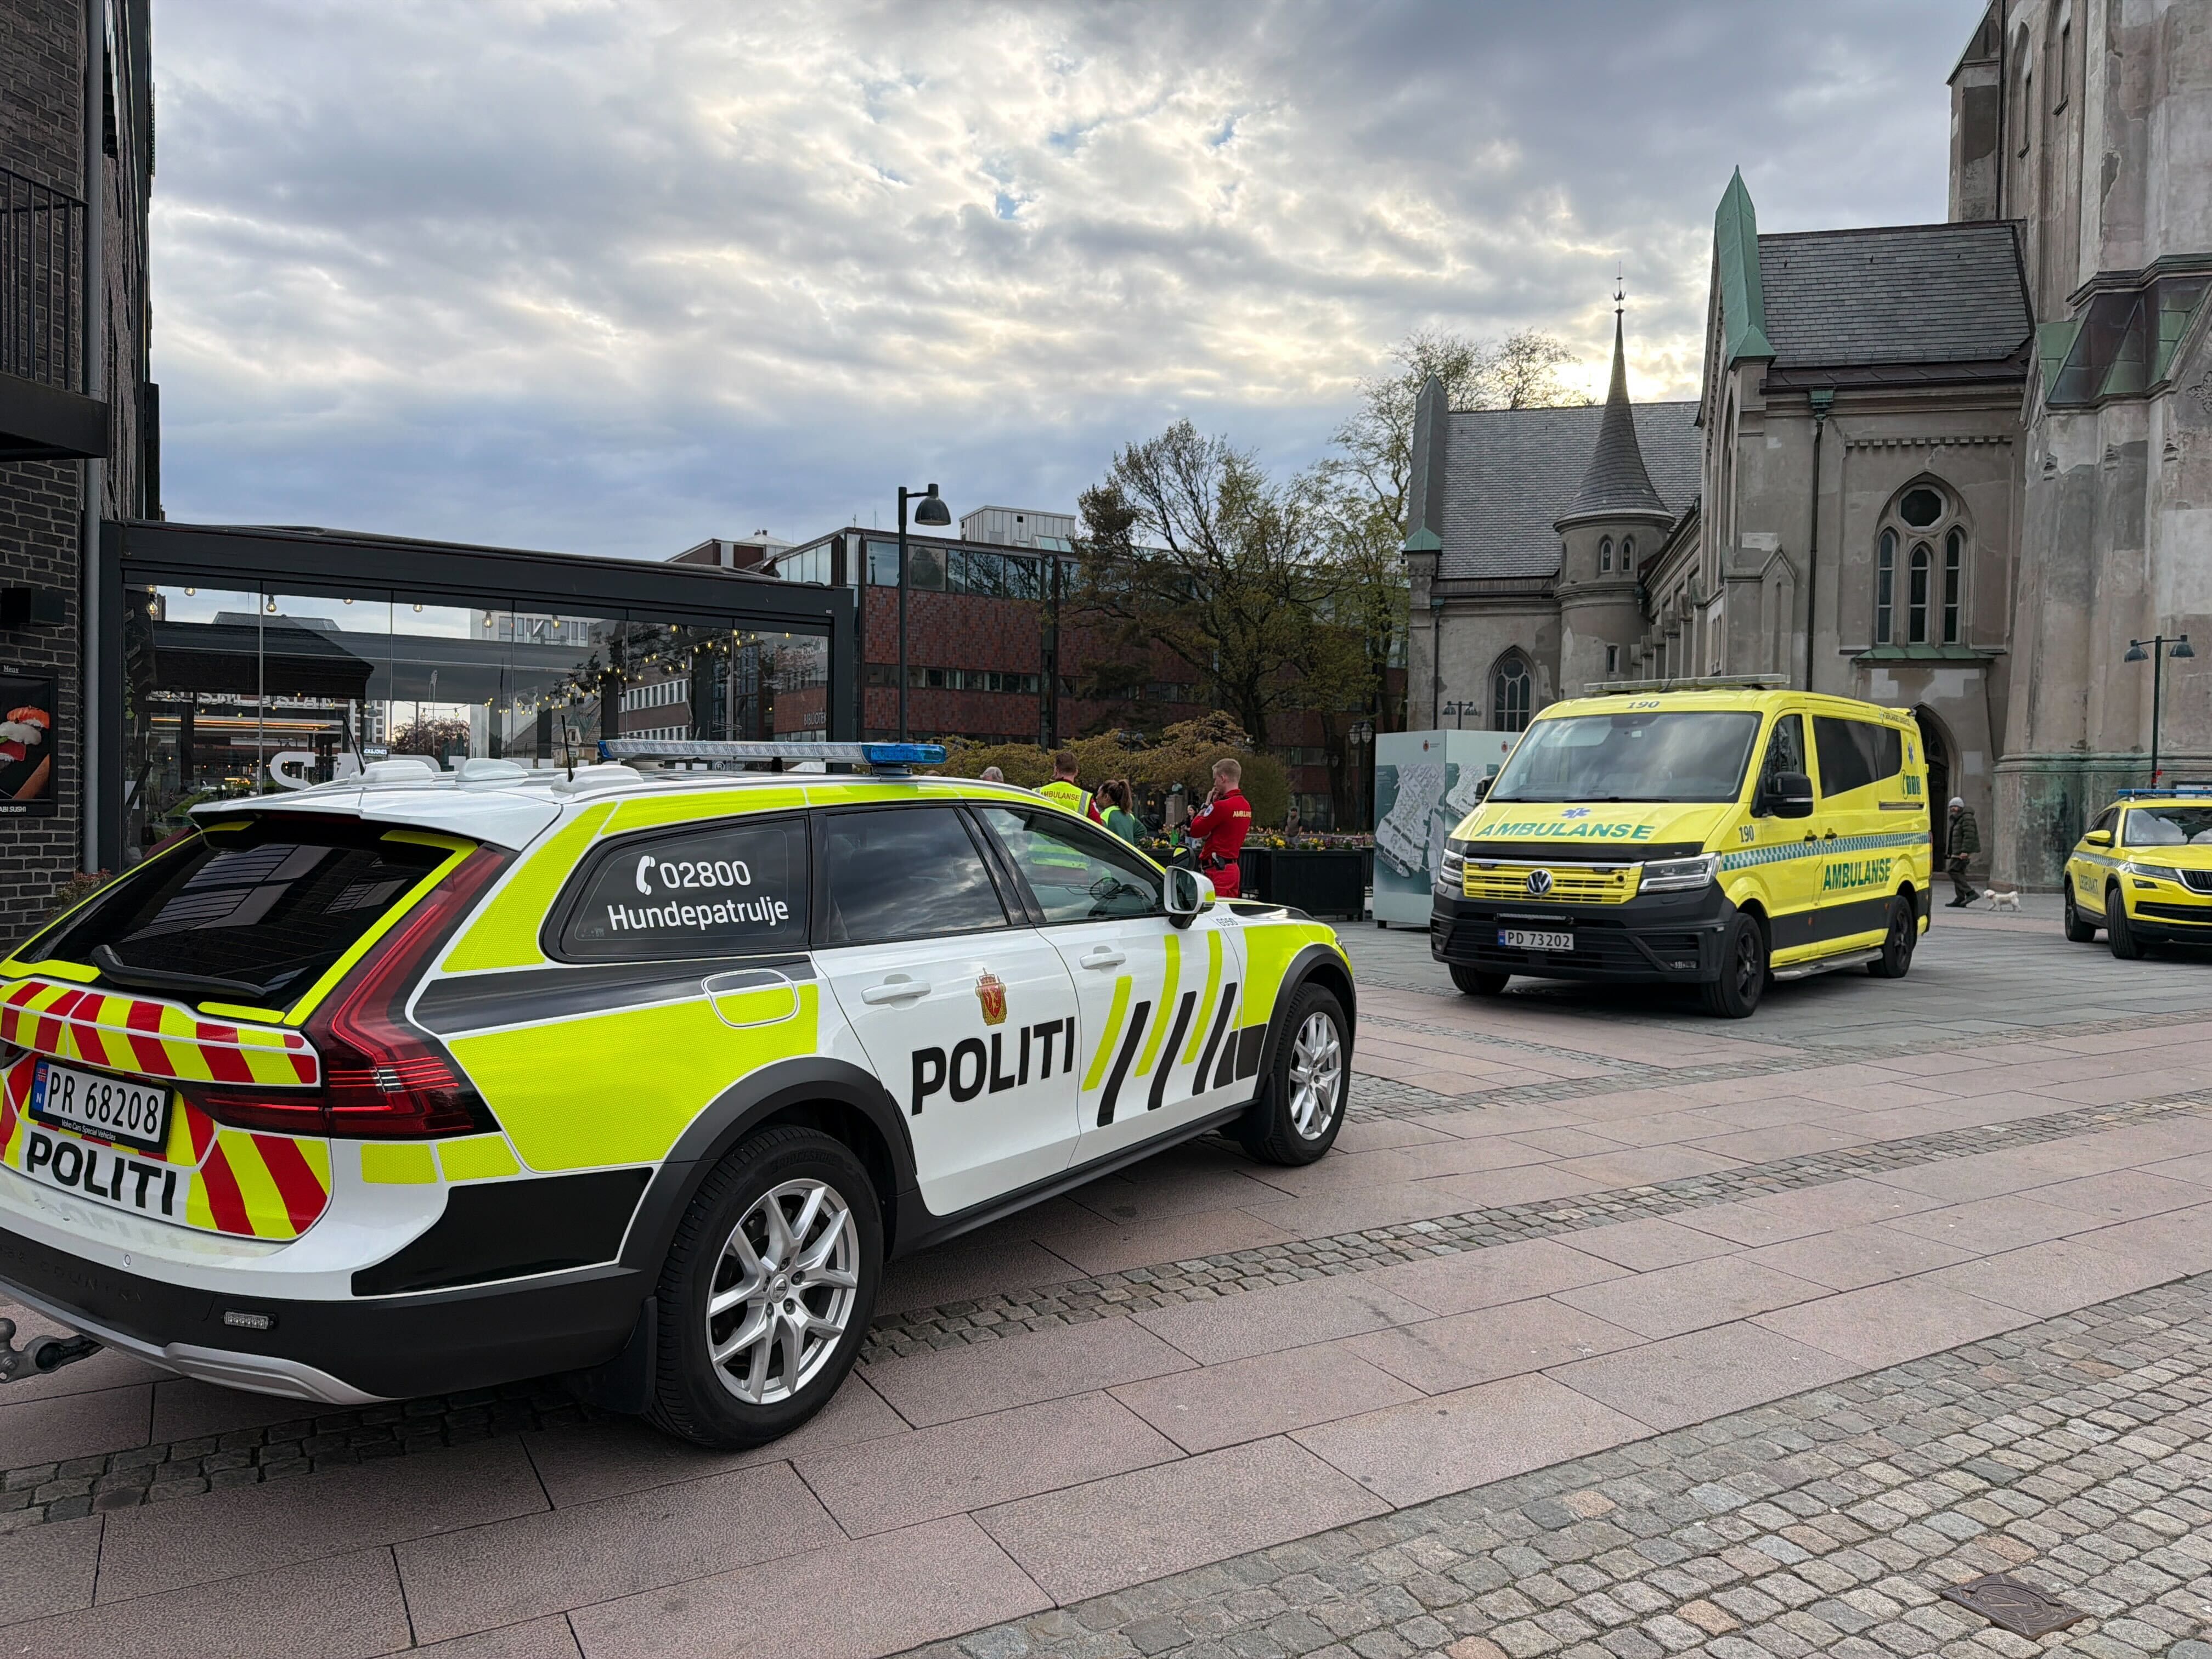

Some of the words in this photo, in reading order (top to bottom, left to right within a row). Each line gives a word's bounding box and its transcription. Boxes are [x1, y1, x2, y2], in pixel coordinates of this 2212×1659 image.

[3, 665, 19, 674] Meny
[1041, 791, 1080, 801] MBULANSE
[1475, 822, 1655, 840] AMBULANSE
[1739, 825, 1754, 843] 190
[660, 859, 751, 889] 02800
[1822, 857, 1892, 891] AMBULANSE
[607, 896, 789, 931] Hundepatrulje
[1508, 932, 1524, 945] PD
[1530, 934, 1570, 948] 73202
[911, 1016, 1075, 1116] POLITI
[36, 1093, 42, 1104] N
[47, 1071, 76, 1114] PR
[84, 1082, 159, 1135] 68208
[61, 1119, 72, 1128] Volvo
[72, 1122, 82, 1131] Cars
[82, 1125, 97, 1136] Special
[98, 1129, 116, 1141] Vehicles
[27, 1131, 177, 1216] POLITI
